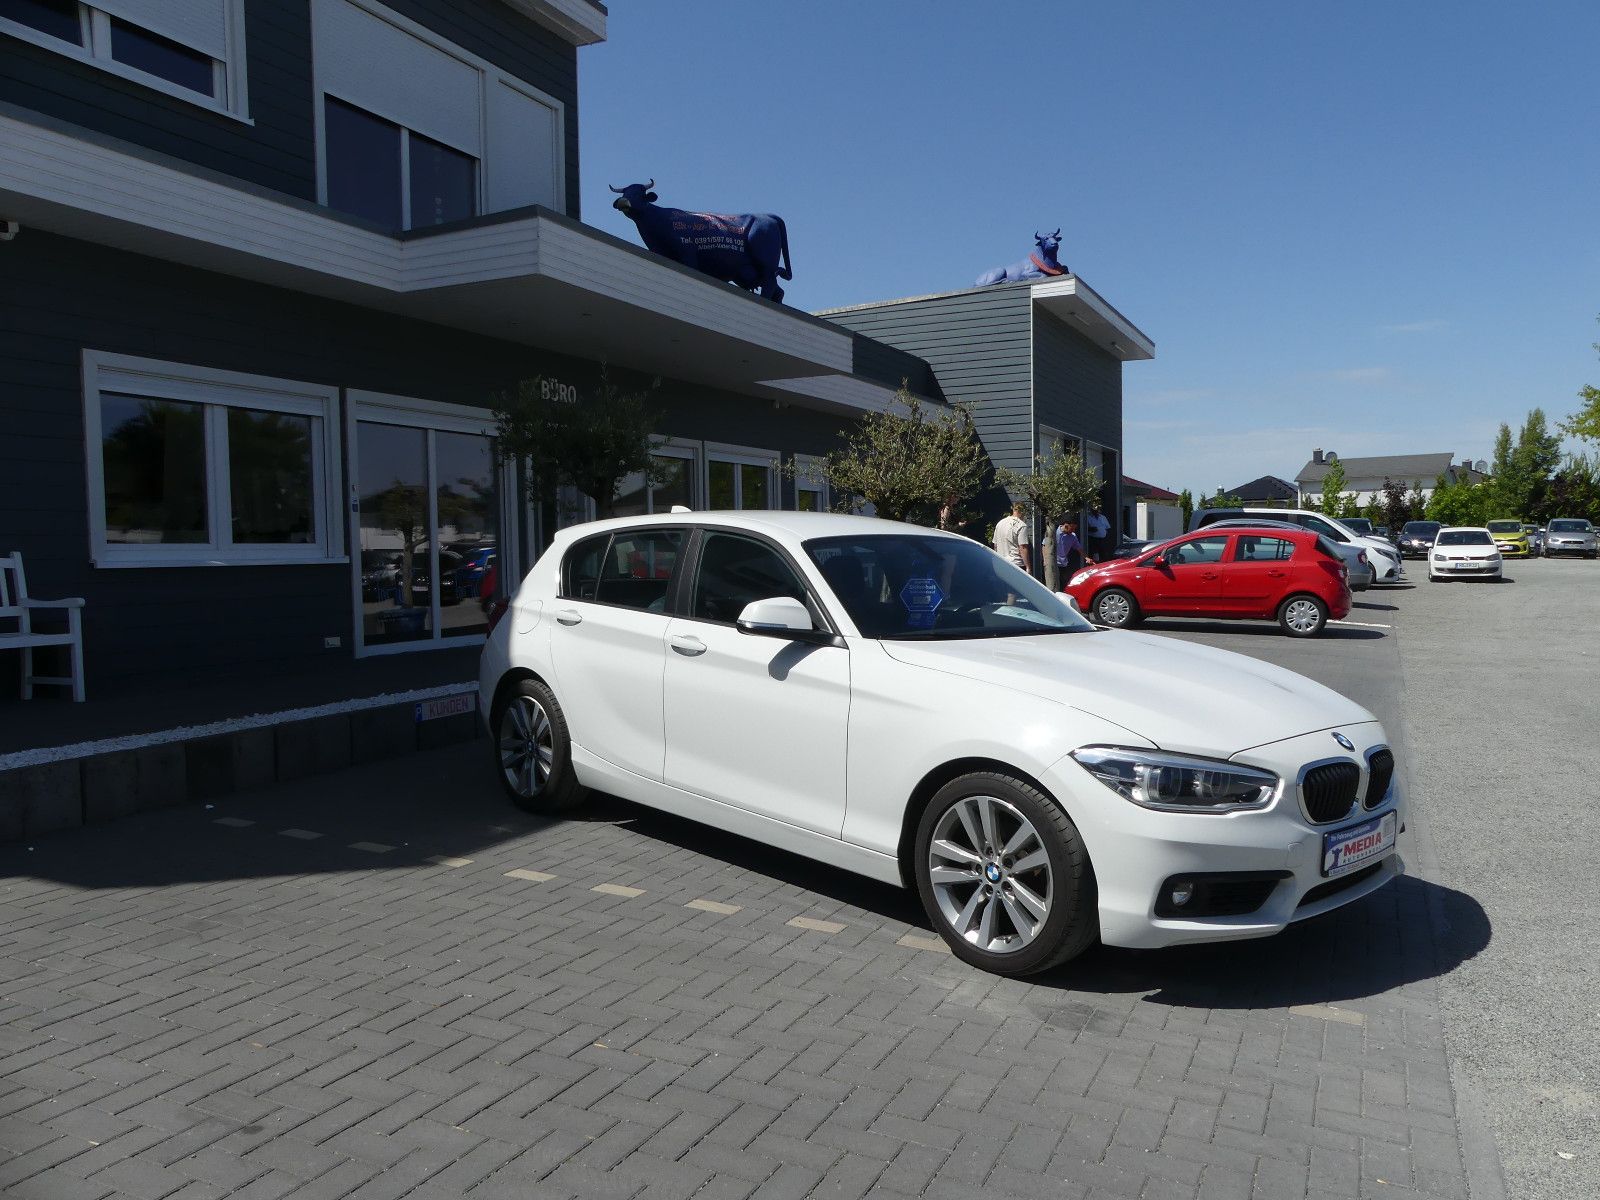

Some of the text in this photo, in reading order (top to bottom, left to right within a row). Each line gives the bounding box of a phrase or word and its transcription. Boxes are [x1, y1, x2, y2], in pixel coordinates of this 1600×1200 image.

[680, 236, 693, 244] Tel.
[542, 378, 577, 403] BÜRO
[429, 697, 469, 718] KUNDEN
[1343, 832, 1382, 857] MEDIA
